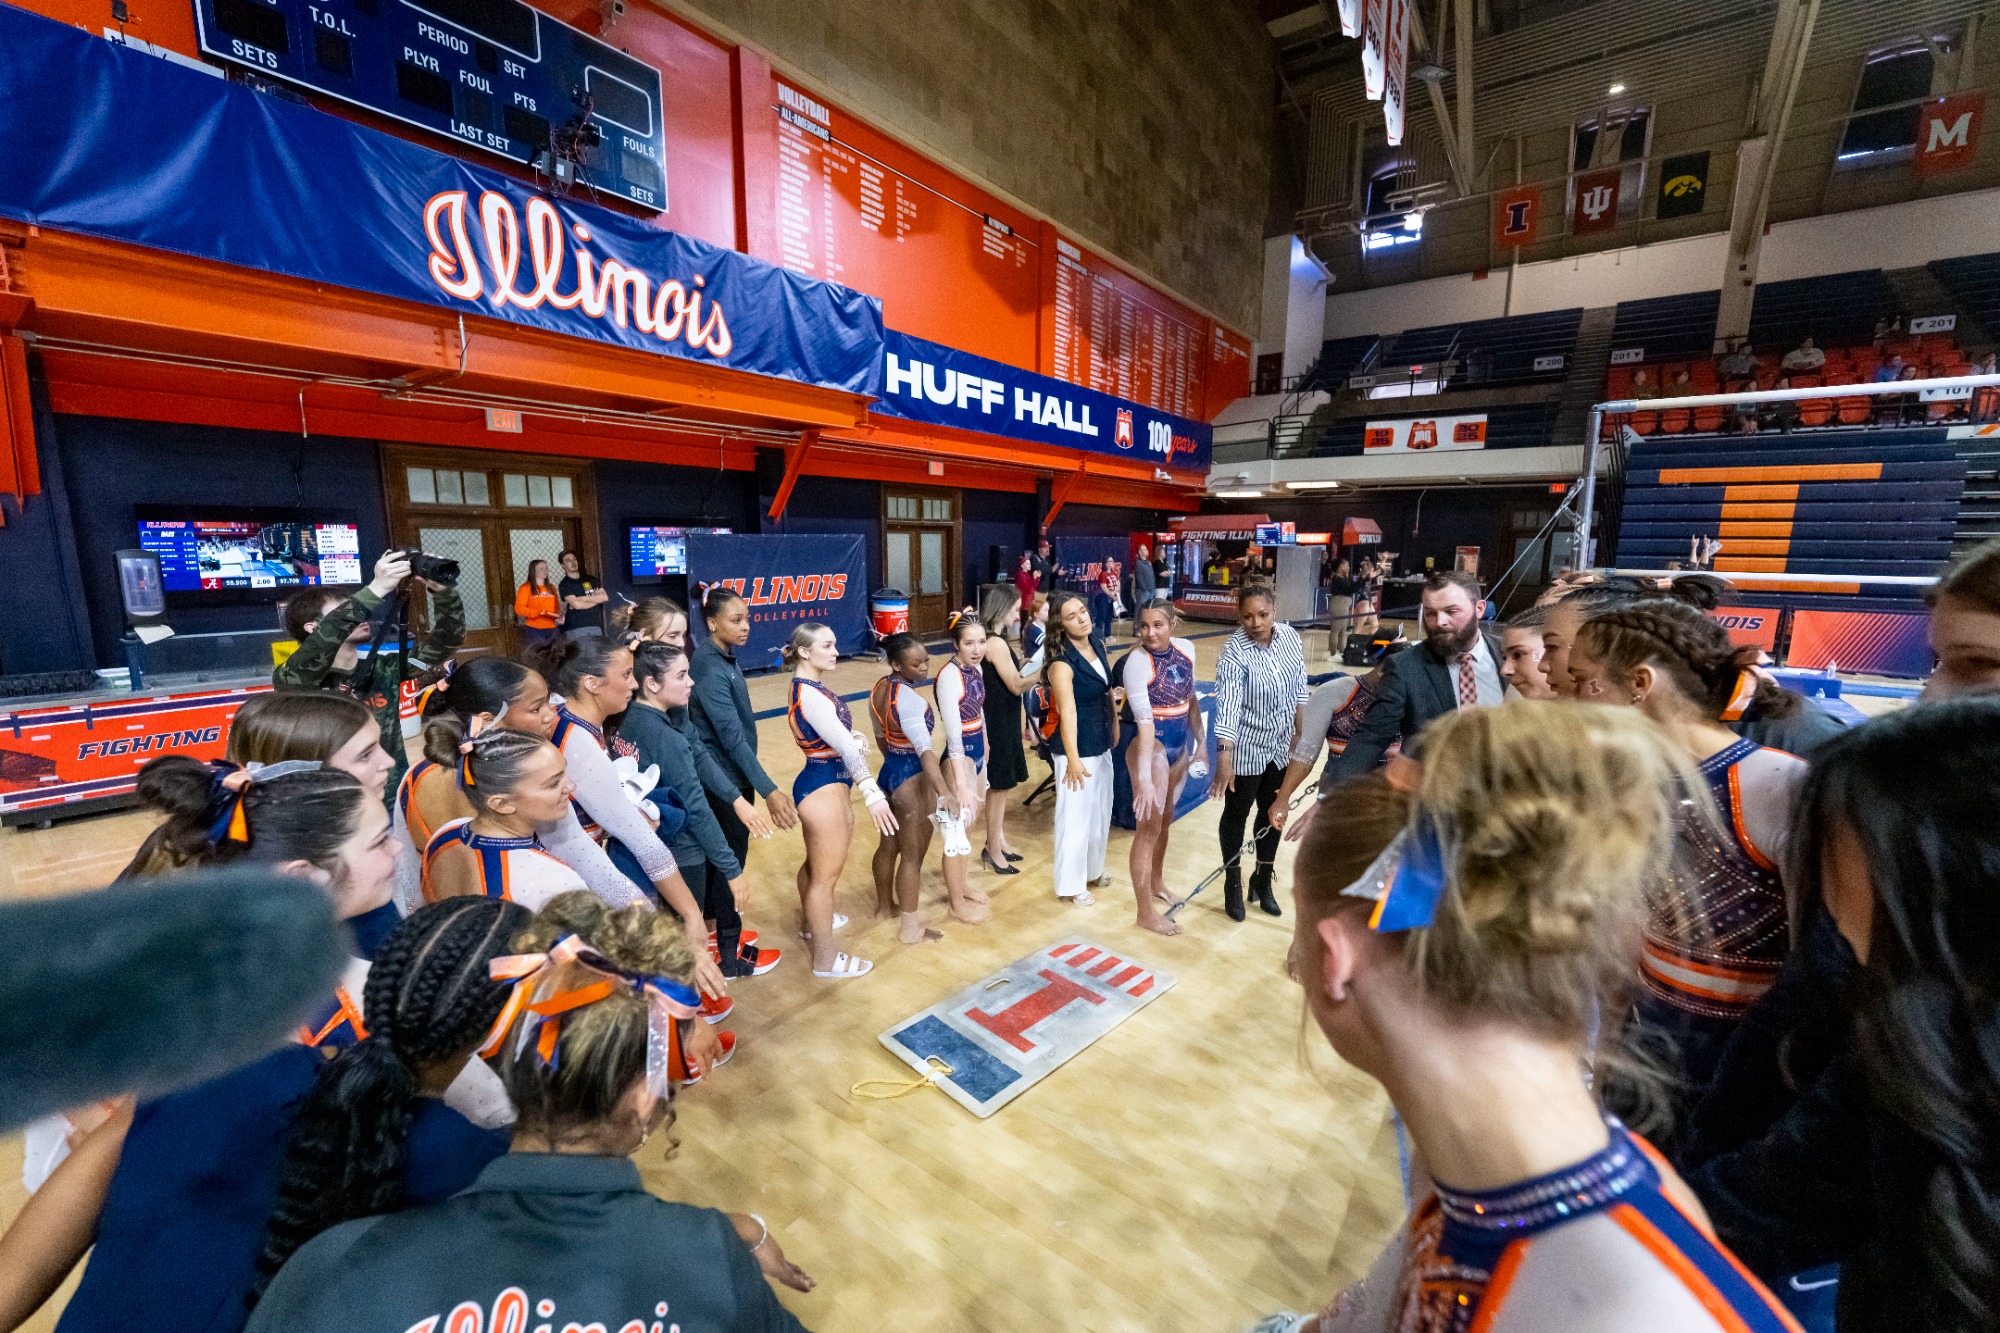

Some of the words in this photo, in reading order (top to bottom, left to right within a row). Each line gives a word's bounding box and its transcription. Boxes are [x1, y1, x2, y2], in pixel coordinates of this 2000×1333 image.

[308, 5, 357, 38] T.O.L.
[418, 21, 469, 55] PERIOD
[232, 39, 278, 68] SETS
[403, 46, 440, 73] PLYR
[459, 69, 494, 95] FOUL
[503, 60, 526, 80] SET
[514, 92, 537, 112] PTS
[777, 82, 831, 127] VOLLEYBALL
[450, 118, 483, 142] LAST
[487, 132, 510, 152] SET
[781, 106, 830, 142] ALL-AMERICANS
[1924, 111, 1974, 153] M
[623, 136, 655, 158] FOULS
[630, 185, 654, 204] SETS
[423, 190, 733, 358] Illinois
[1928, 319, 1953, 328] 201
[1546, 357, 1563, 366] 200
[1613, 351, 1631, 360] 201
[886, 352, 1005, 415] HUFF
[1014, 387, 1099, 437] HALL
[493, 410, 517, 429] EXIT
[1147, 419, 1172, 454] 100
[1165, 434, 1198, 464] years
[1181, 531, 1227, 540] FIGHTING
[1228, 530, 1255, 540] ILLIN
[748, 607, 829, 623] OLLEYBALL
[77, 726, 222, 761] FIGHTING
